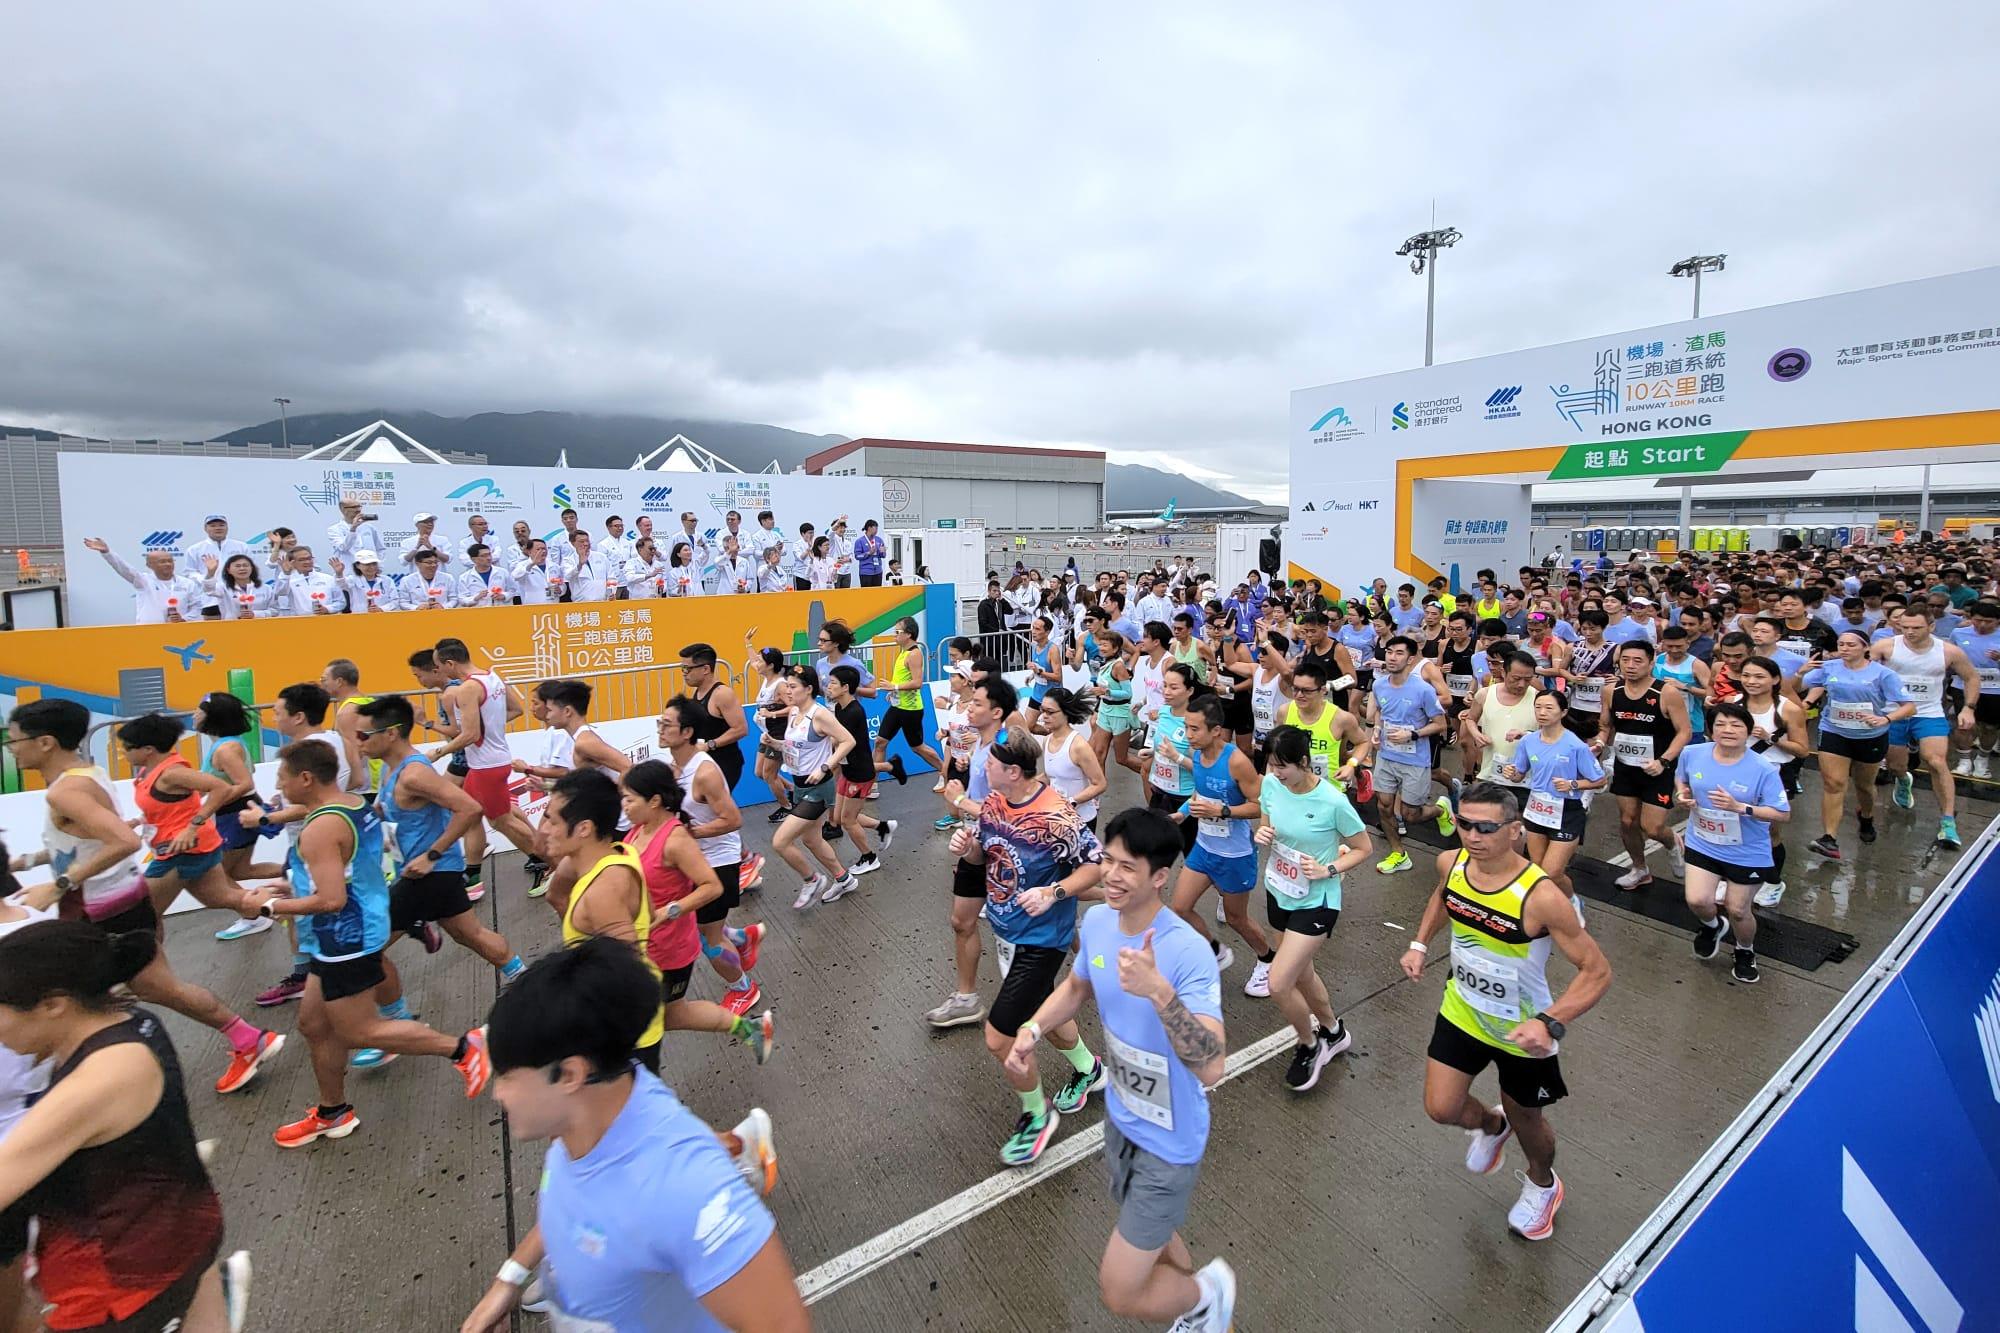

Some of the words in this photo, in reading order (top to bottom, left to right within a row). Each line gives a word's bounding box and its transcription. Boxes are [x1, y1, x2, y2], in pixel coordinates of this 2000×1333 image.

[1836, 327, 2000, 358] 大型體育活動事務委員
[1868, 351, 1903, 363] Sports
[1907, 347, 1943, 357] Events
[1626, 351, 1726, 380] 三跑道系統
[1626, 373, 1725, 401] 10公里跑
[1415, 395, 1460, 409] standard
[1488, 405, 1517, 414] HKAAA
[1626, 402, 1667, 413] RUNWAY
[1669, 399, 1695, 408] 10KM
[1698, 395, 1726, 405] RACE
[1415, 403, 1462, 418] chartered
[1415, 415, 1448, 427] 渣打銀行
[1602, 420, 1651, 435] HONG
[1657, 414, 1712, 430] KONG
[1584, 448, 1629, 469] 起點
[1642, 445, 1706, 465] Start
[577, 485, 620, 493] standard
[577, 492, 623, 500] chartered
[577, 500, 611, 508] 渣打銀行
[1359, 500, 1379, 510] HKT
[1445, 520, 1462, 536] 同步
[566, 626, 653, 647] 三跑道系統
[567, 644, 654, 668] 10公里跑
[1615, 711, 1656, 723] PEGASUS
[1618, 744, 1647, 756] 2067
[1529, 798, 1555, 815] 384
[1698, 817, 1726, 833] 551
[1276, 858, 1298, 880] 850
[1491, 916, 1518, 931] Post
[1456, 965, 1506, 999] 6029
